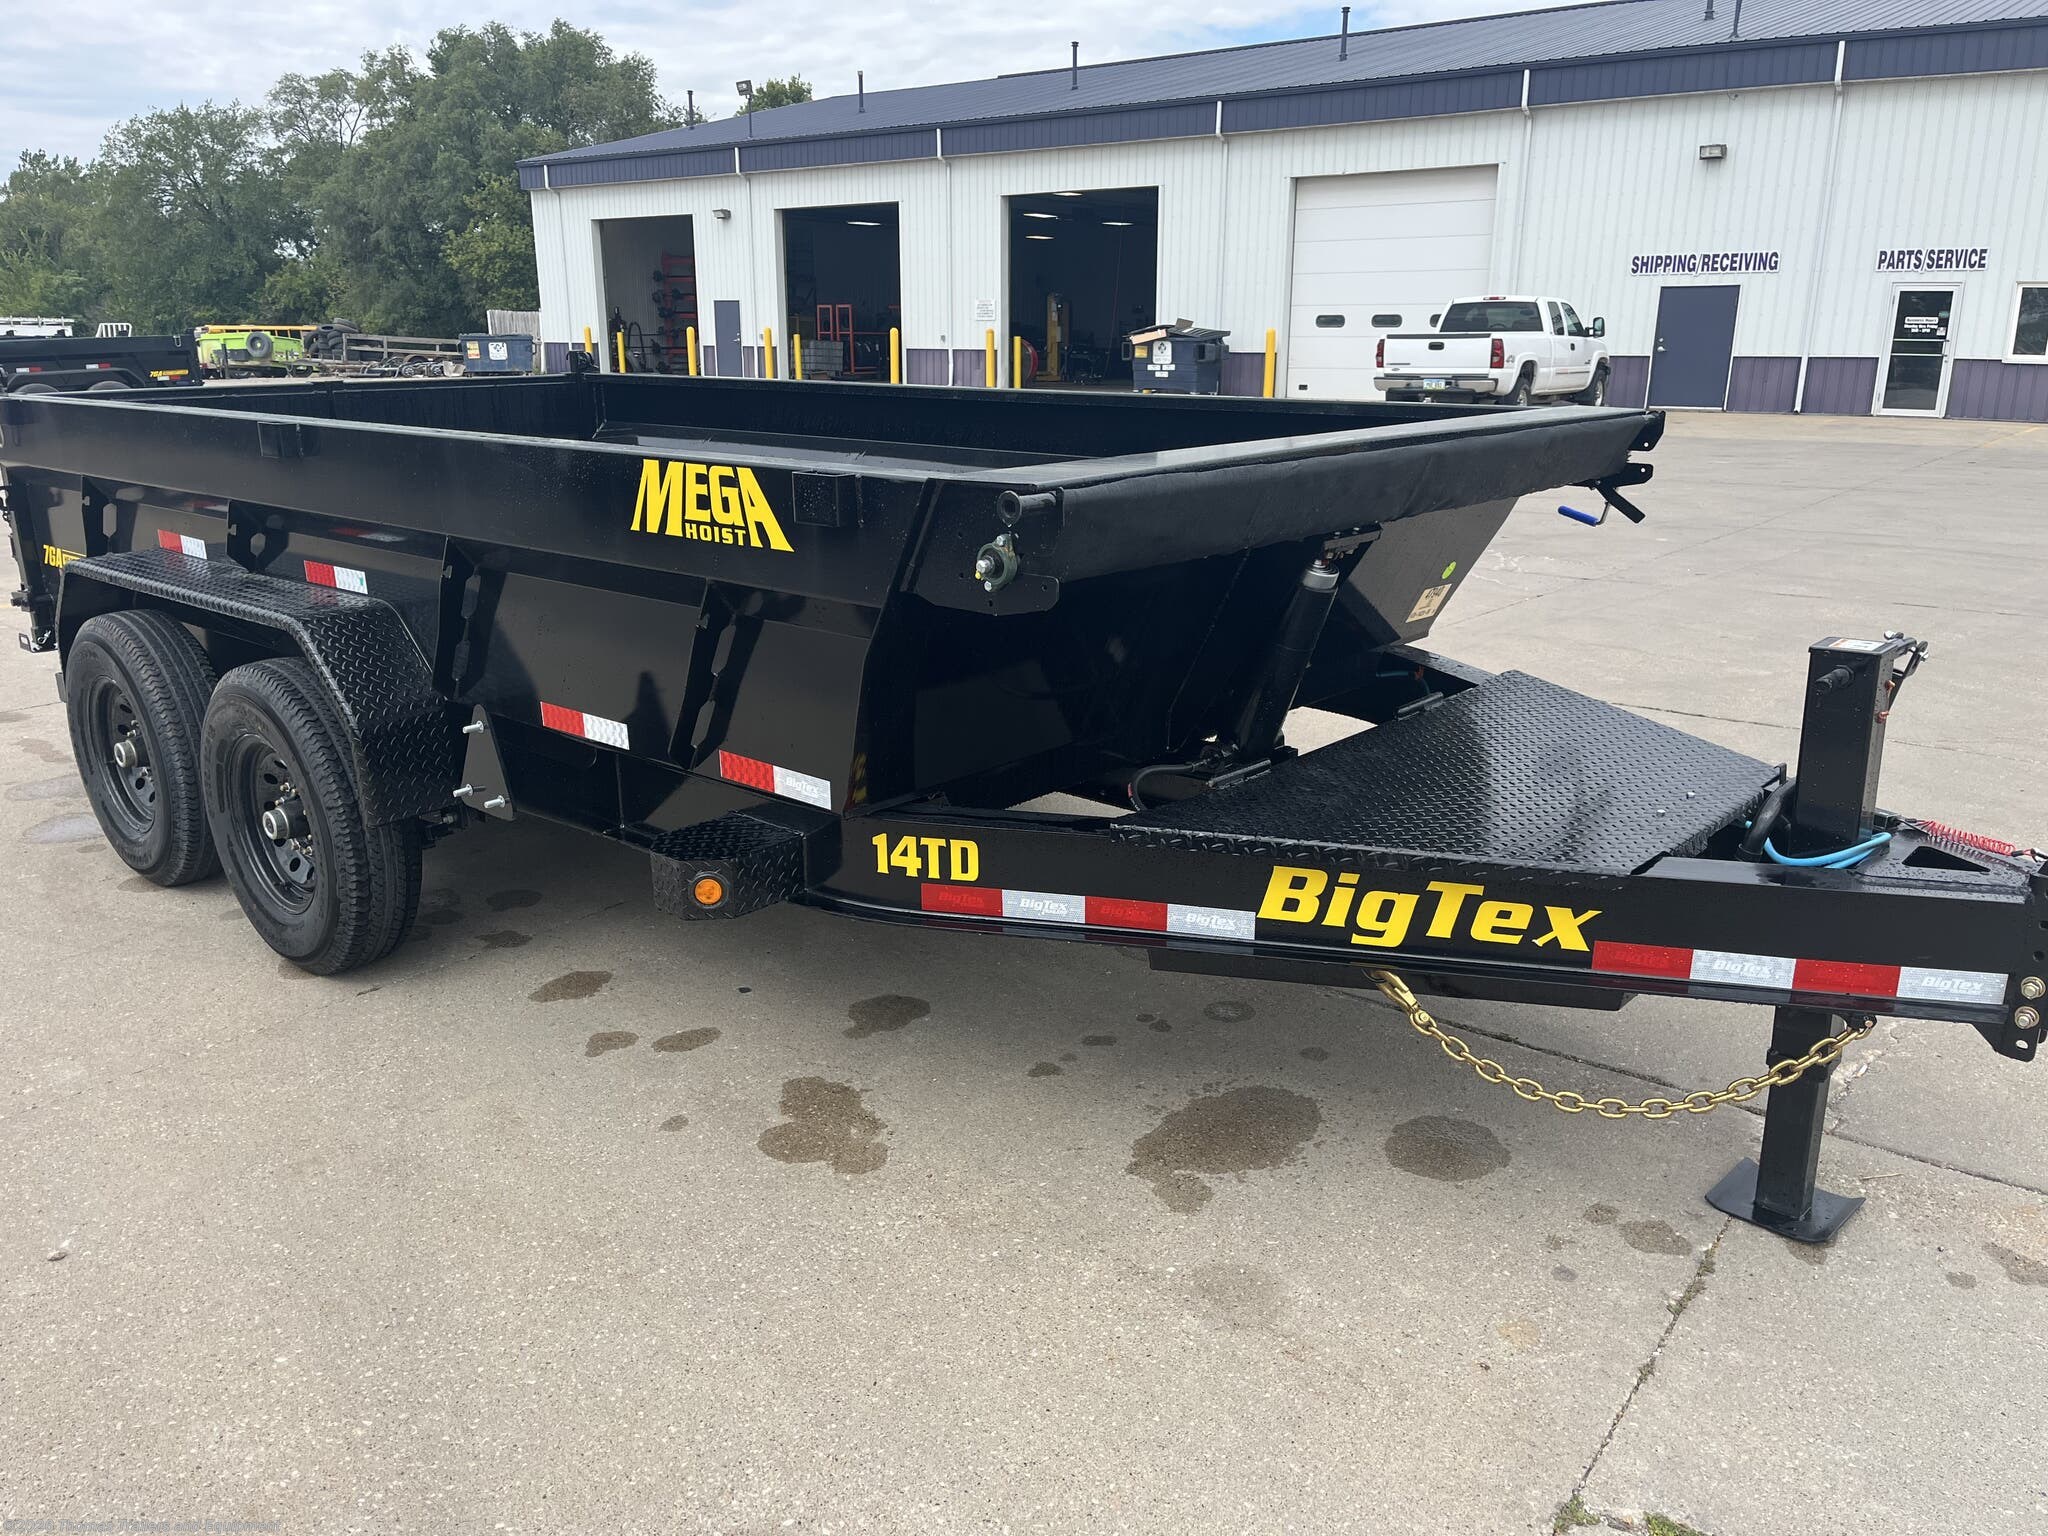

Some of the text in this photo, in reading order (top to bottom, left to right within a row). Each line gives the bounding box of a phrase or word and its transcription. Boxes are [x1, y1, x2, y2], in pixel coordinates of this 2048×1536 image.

[1631, 251, 1779, 274] SHIPPING/RECEIVING
[1877, 248, 1988, 271] PARTS/SERVICE
[630, 458, 795, 552] MEGA
[685, 522, 746, 546] HOIST
[43, 544, 63, 568] 7GA
[872, 832, 980, 882] 14TD
[1019, 898, 1069, 914] BigTex
[1256, 865, 1603, 952] BigTex
[1185, 912, 1237, 930] BigTex
[1712, 958, 1773, 976] BigTex
[1921, 976, 1984, 992] BigTex
